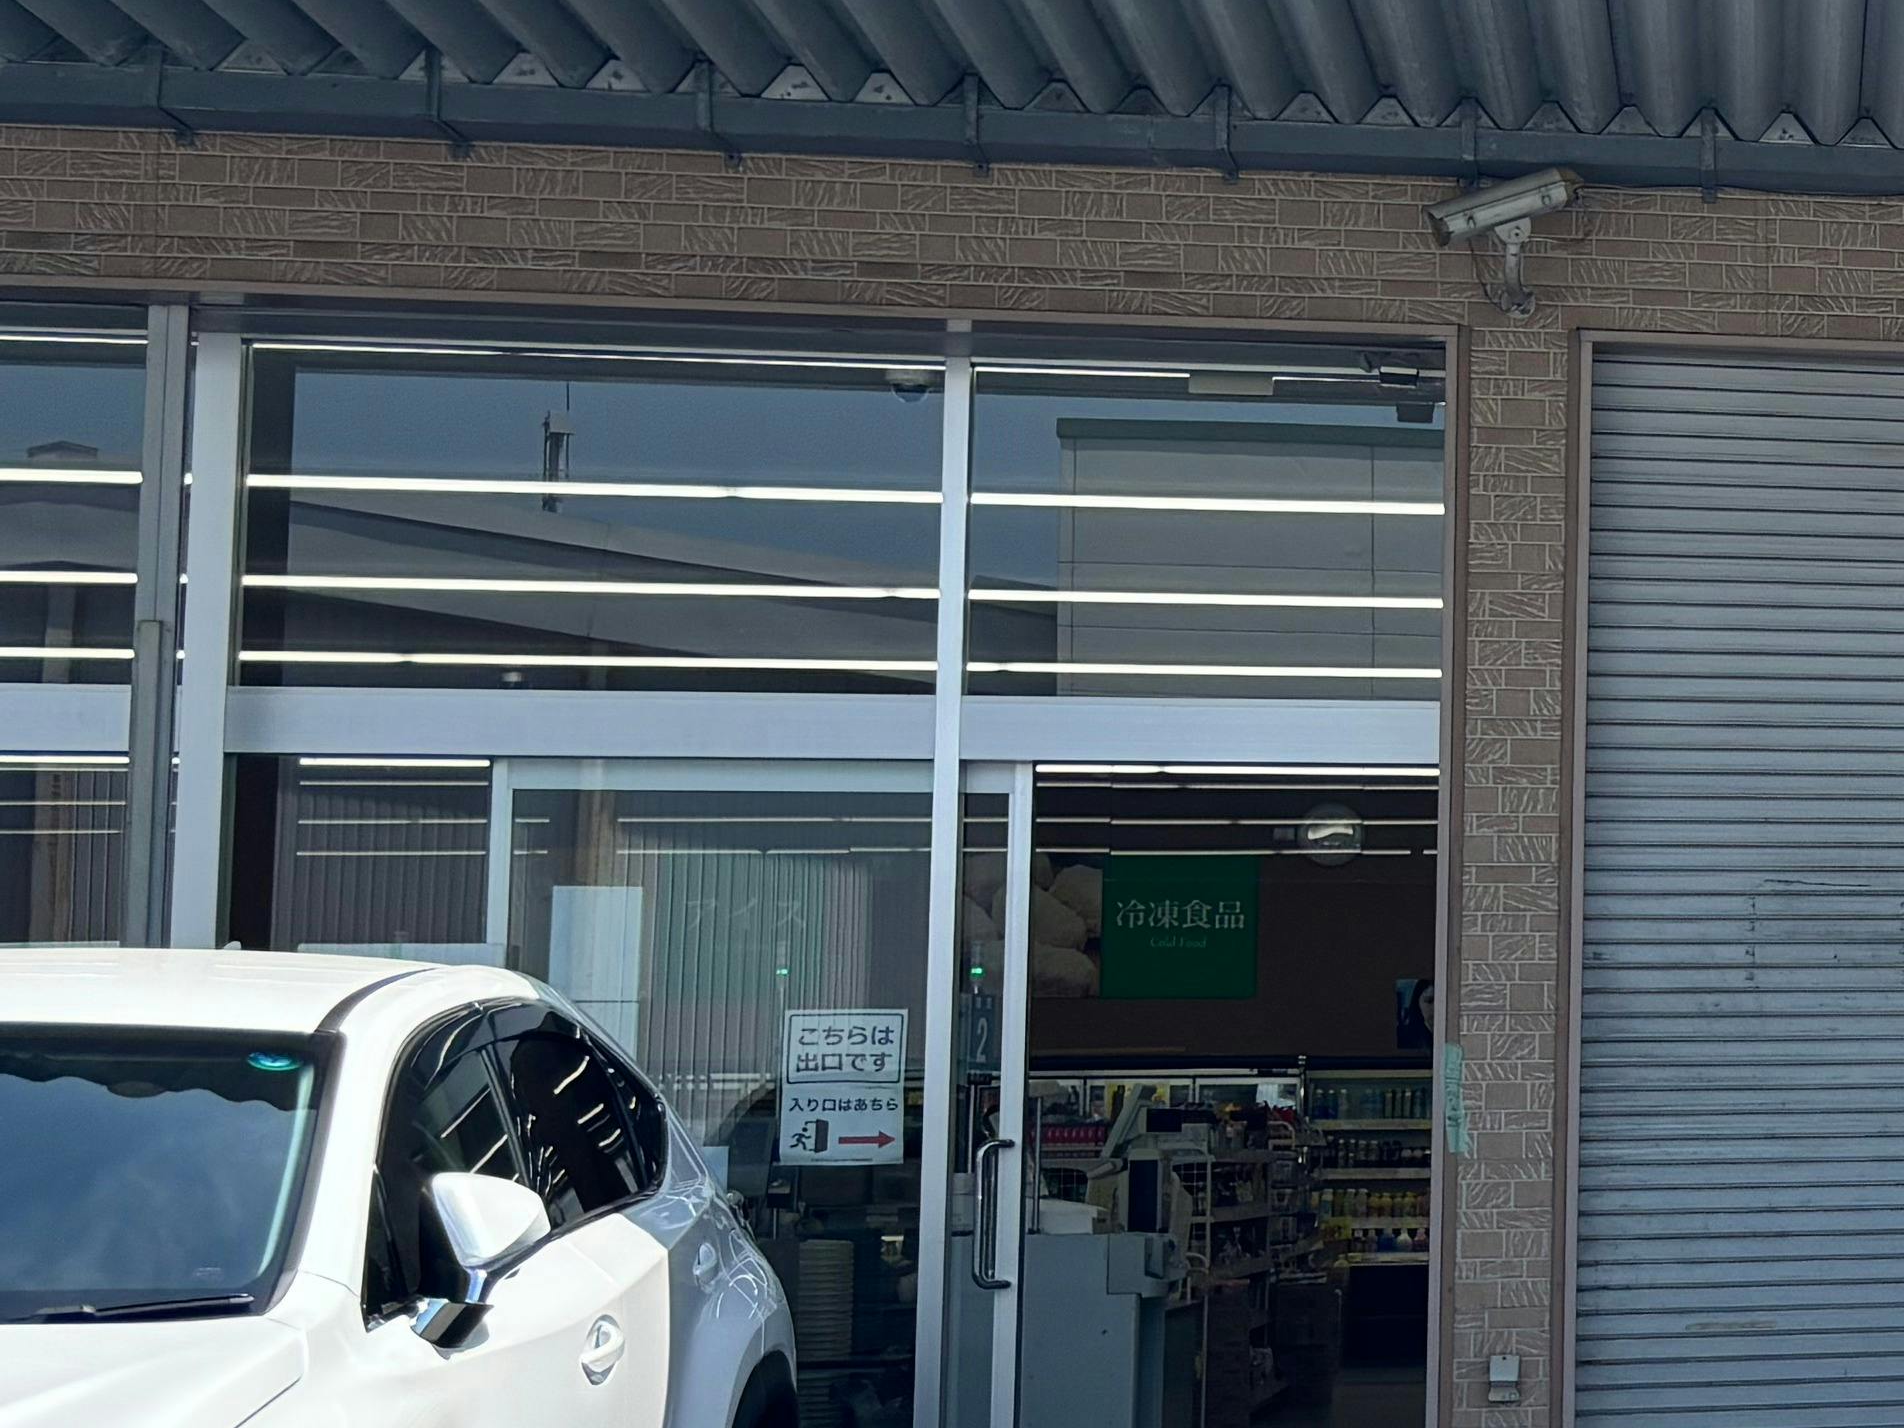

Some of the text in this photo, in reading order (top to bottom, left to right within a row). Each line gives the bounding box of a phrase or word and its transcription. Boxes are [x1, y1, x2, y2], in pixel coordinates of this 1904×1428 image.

[1116, 899, 1246, 930] 冷凍食品
[798, 1025, 895, 1047] こちらは
[796, 1052, 893, 1073] 出口です
[788, 1097, 899, 1113] 入り口はあちら
